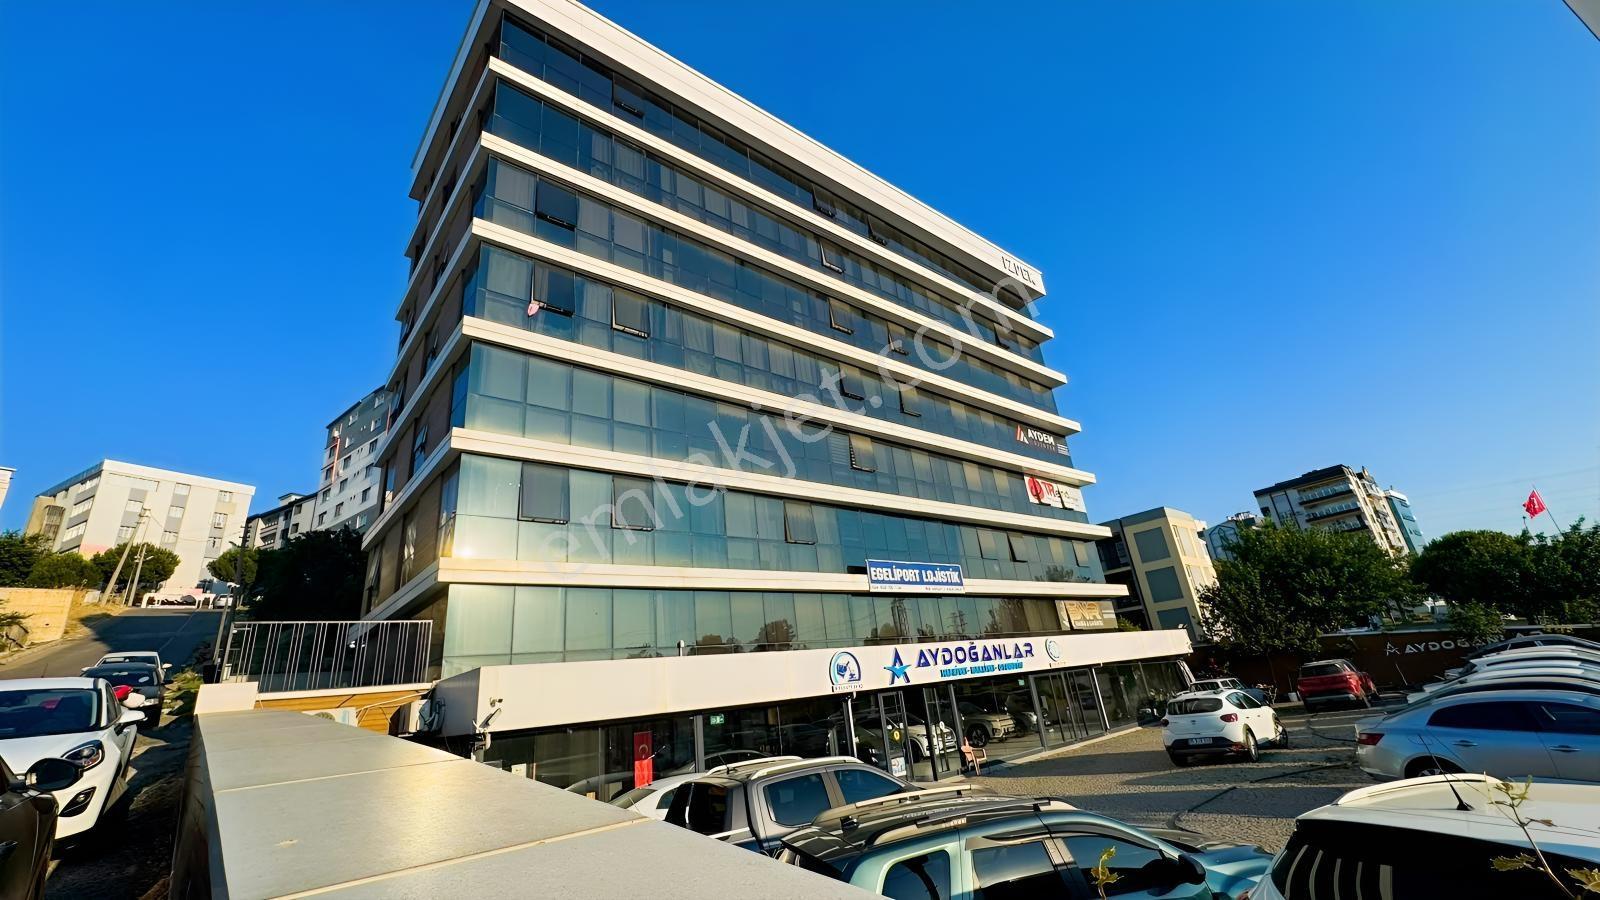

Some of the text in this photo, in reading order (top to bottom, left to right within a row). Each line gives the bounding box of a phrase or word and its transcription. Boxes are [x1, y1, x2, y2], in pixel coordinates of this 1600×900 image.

[1027, 428, 1055, 446] AYDEM
[870, 565, 961, 583] EGELİPORT LOJİSTİK
[915, 641, 1034, 668] AYDOĞANLAR
